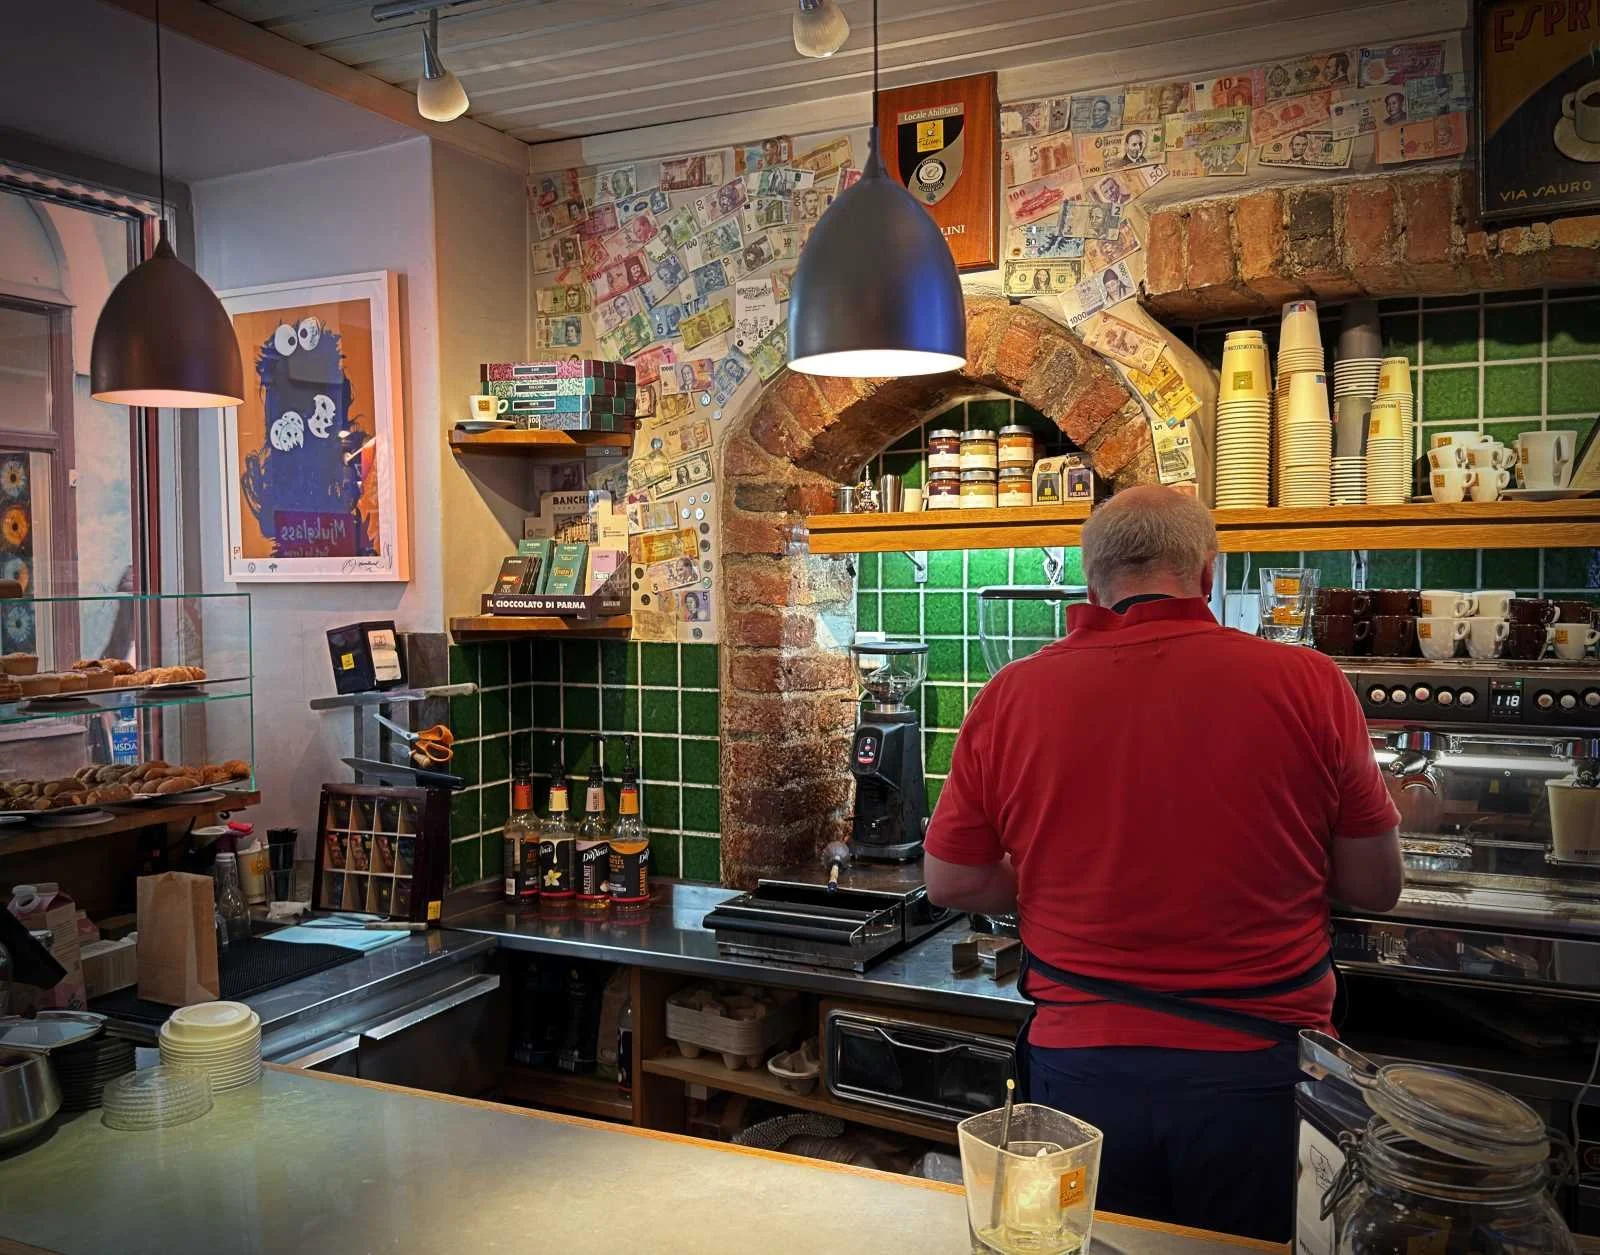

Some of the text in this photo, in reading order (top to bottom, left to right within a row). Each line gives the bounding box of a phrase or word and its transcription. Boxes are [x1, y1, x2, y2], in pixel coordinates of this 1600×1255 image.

[1494, 0, 1600, 53] ESPR
[1218, 78, 1232, 92] 10
[904, 111, 927, 121] Locale
[1149, 167, 1163, 182] 50
[1008, 188, 1026, 201] 100
[1499, 180, 1593, 202] VIA SAURO
[1114, 206, 1121, 215] 2
[940, 224, 965, 236] LINI
[1070, 311, 1087, 325] 1000
[656, 323, 664, 335] 5
[1176, 437, 1189, 446] 5
[486, 599, 586, 609] IL CIOCCOLATO DI PARMA
[1496, 695, 1520, 708] 118
